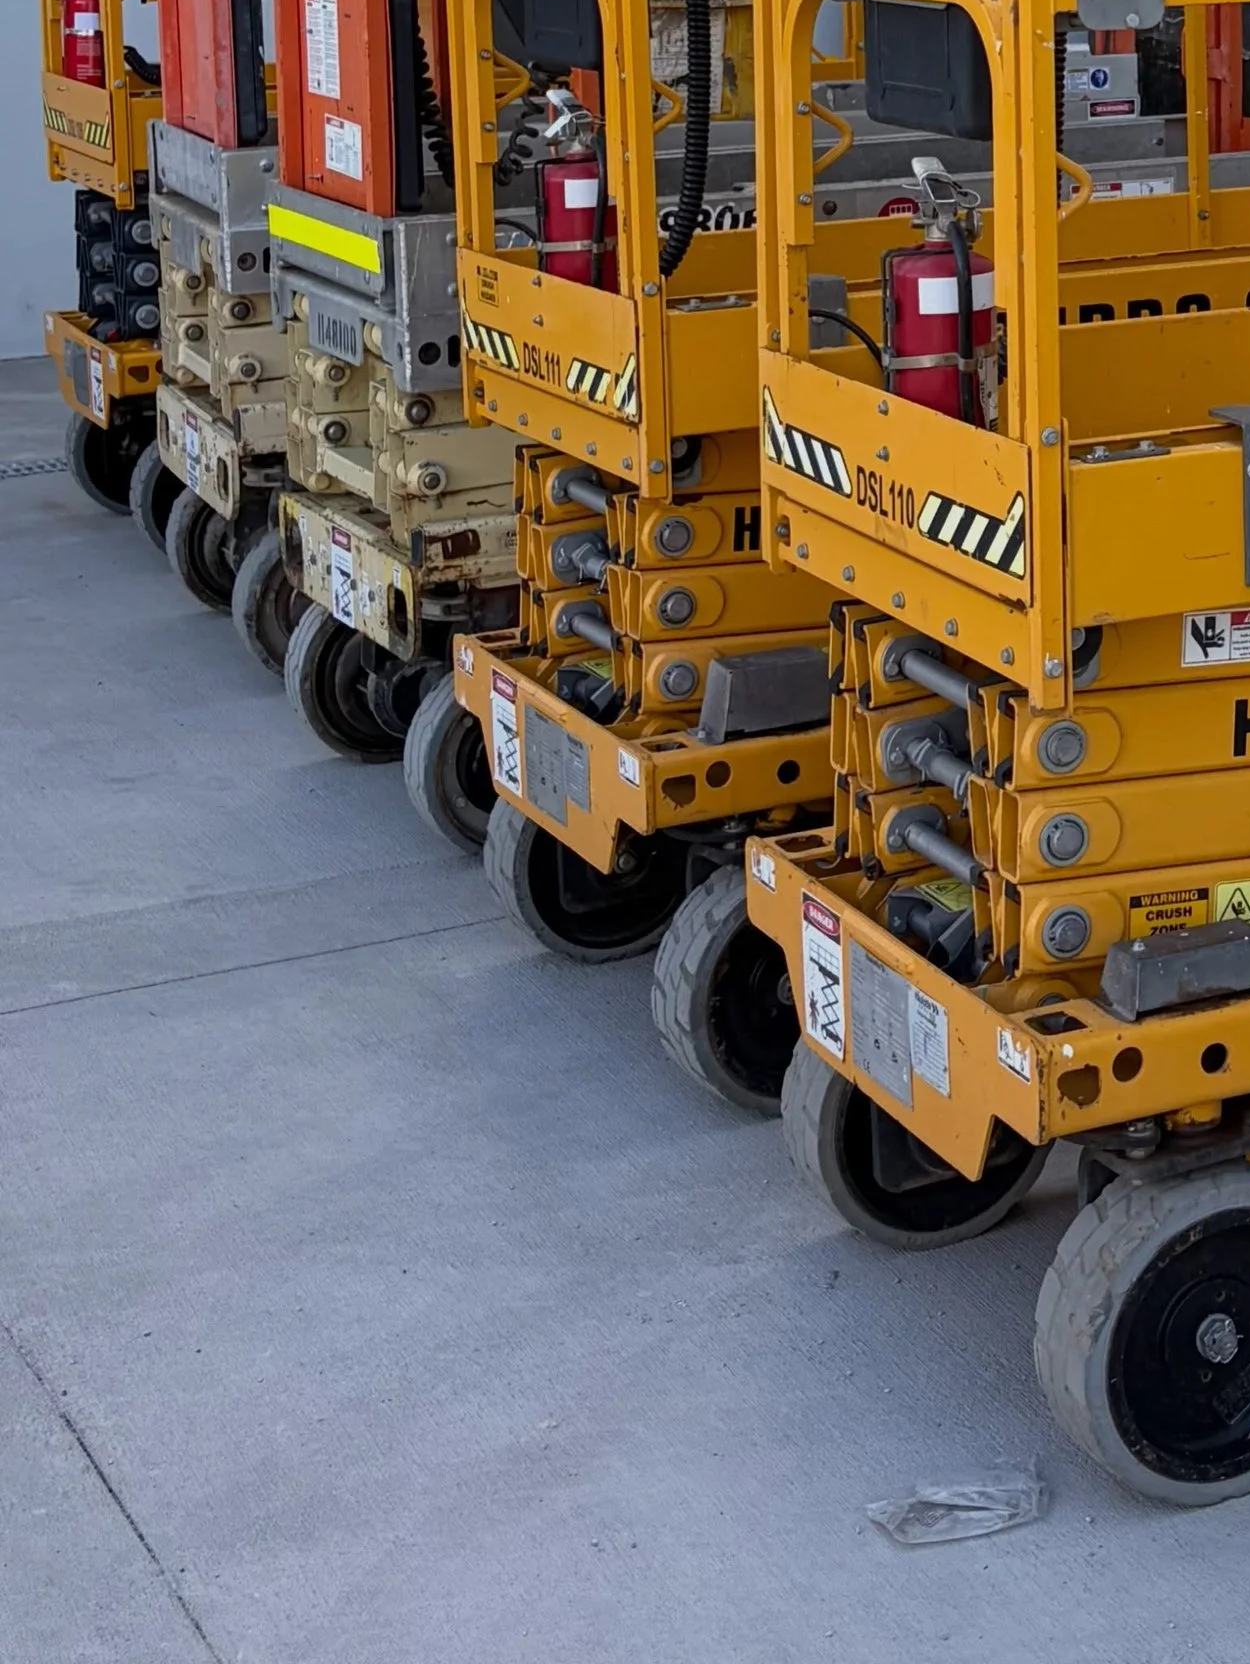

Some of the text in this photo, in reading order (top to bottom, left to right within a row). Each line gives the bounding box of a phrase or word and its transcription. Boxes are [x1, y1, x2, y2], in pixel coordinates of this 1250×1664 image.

[523, 341, 561, 387] DSL111
[856, 464, 915, 529] DSL110
[1140, 889, 1199, 907] WARNING
[1145, 907, 1193, 922] CRUSH
